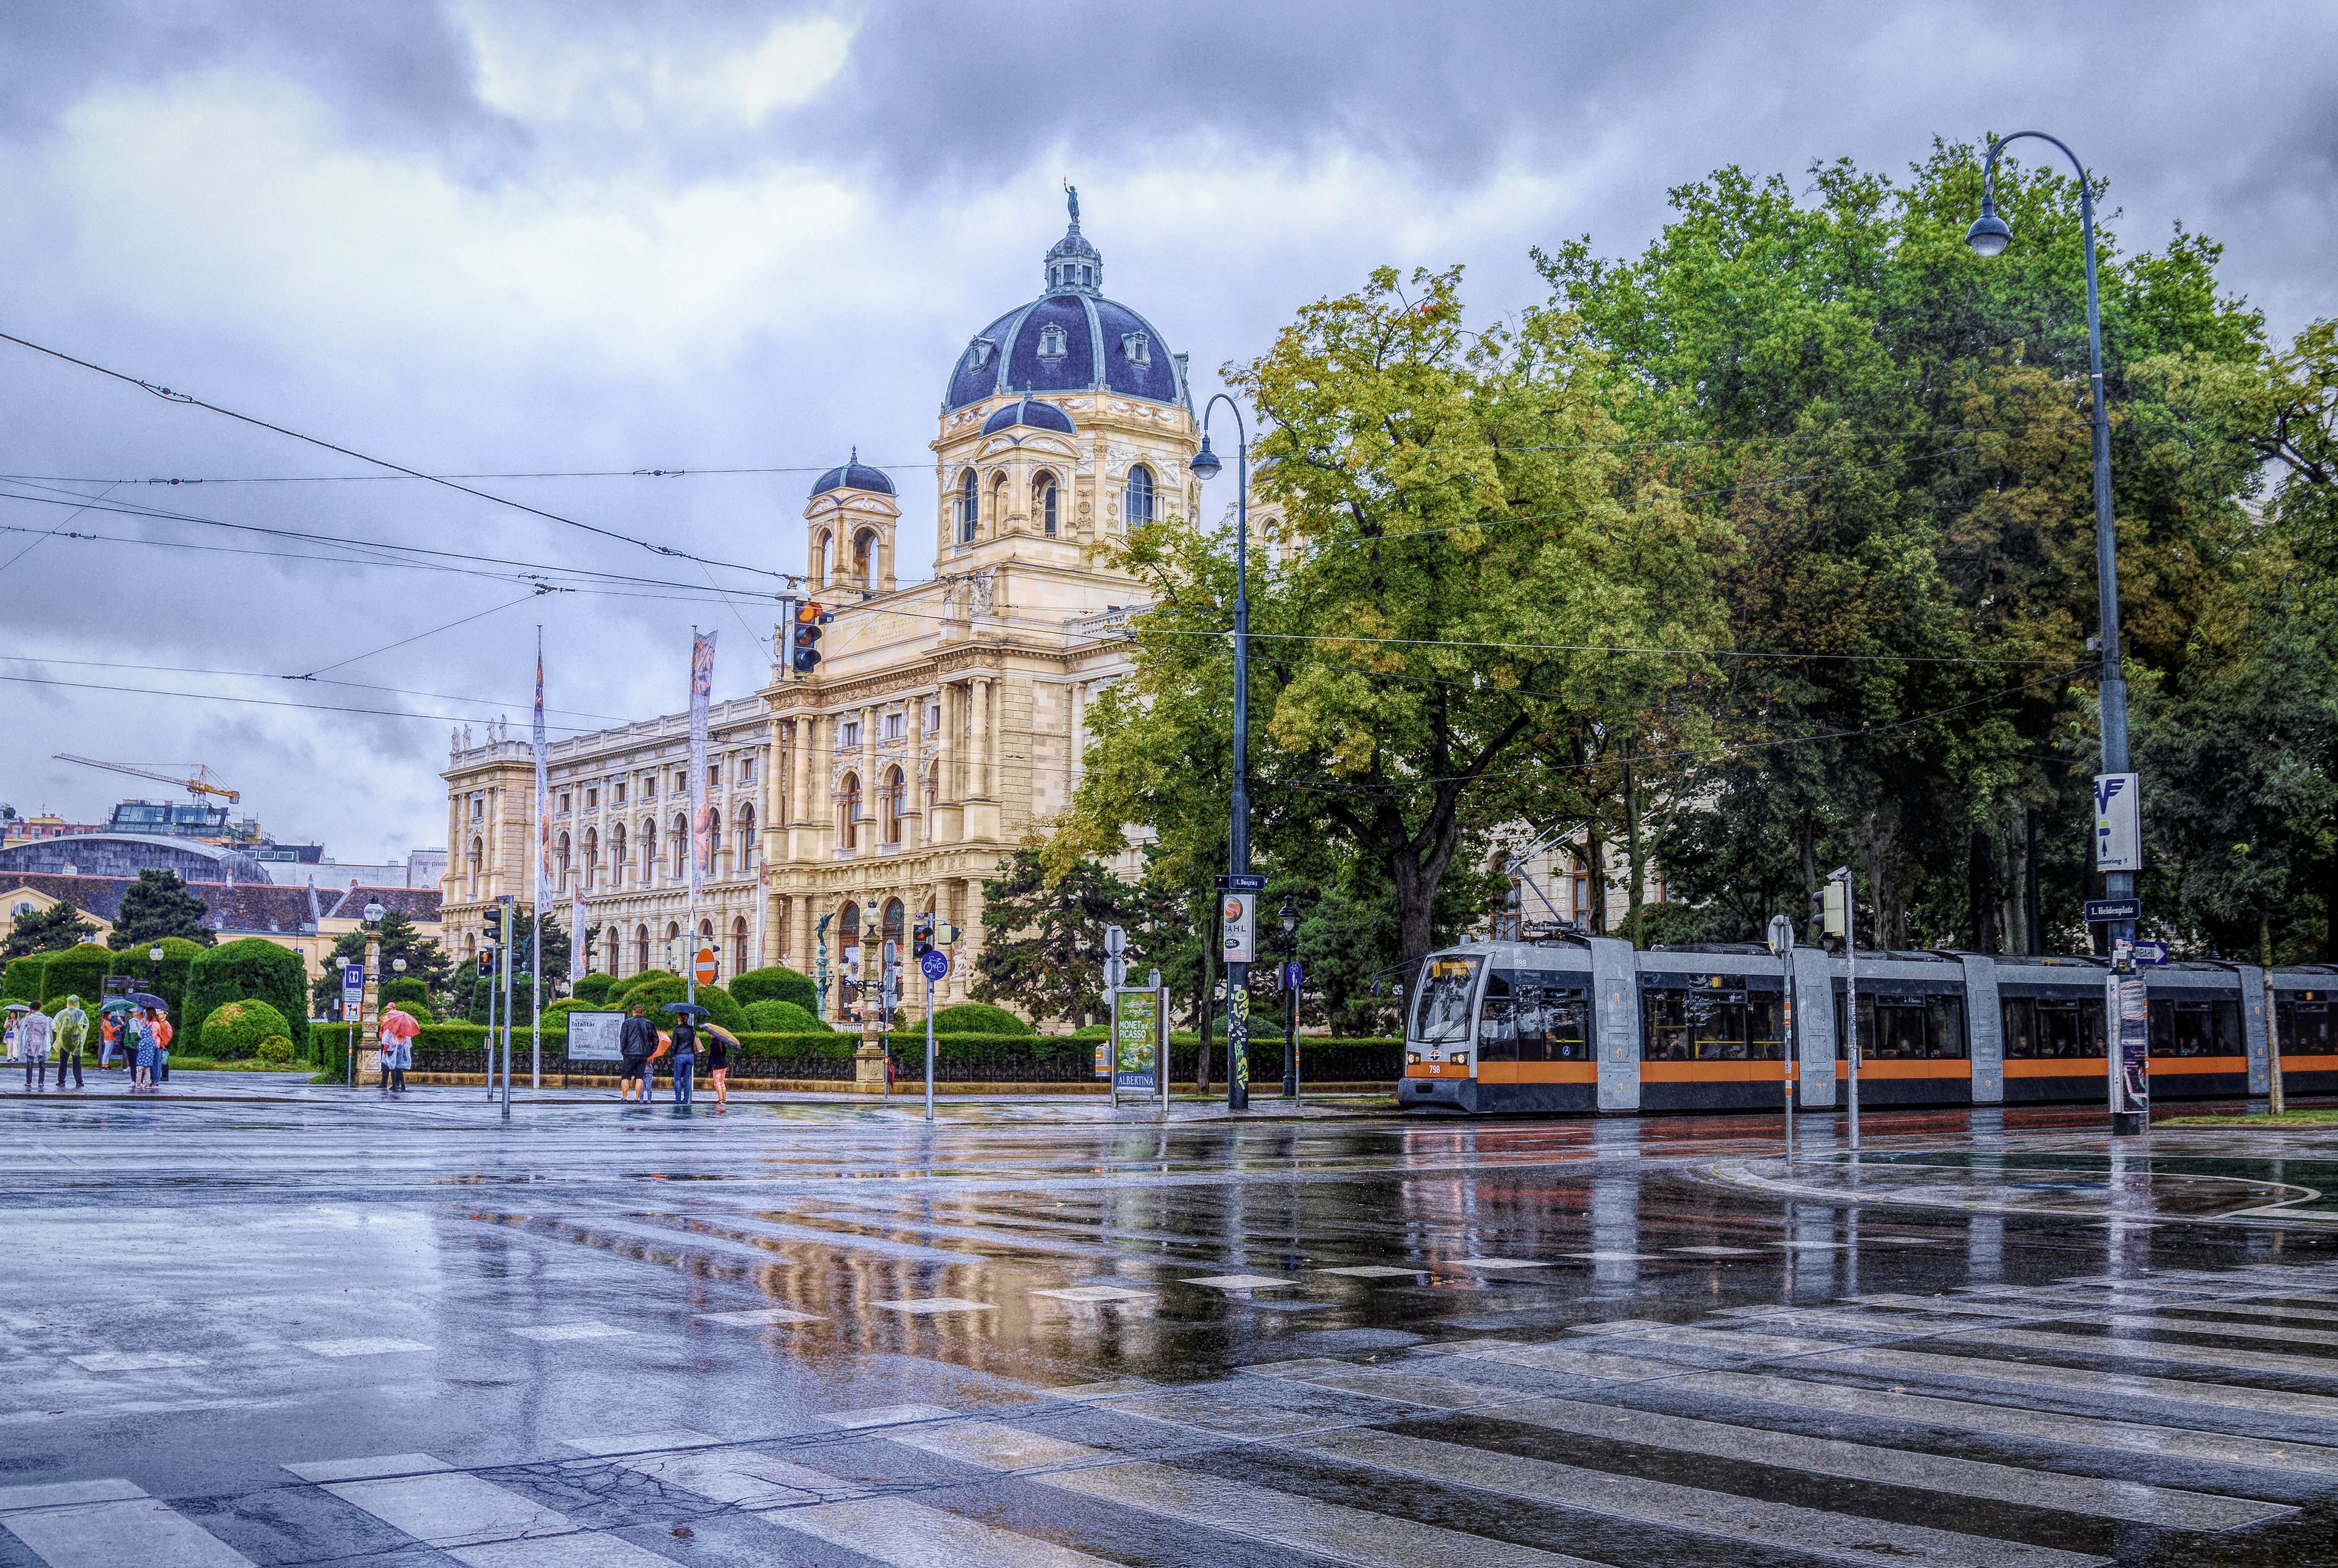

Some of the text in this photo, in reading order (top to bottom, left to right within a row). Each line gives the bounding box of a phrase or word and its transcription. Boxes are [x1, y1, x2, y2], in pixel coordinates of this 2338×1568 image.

[2091, 905, 2133, 916] 1. Heldenplatz
[2136, 947, 2155, 958] NBAHN
[1514, 959, 1527, 967] 798
[1119, 1021, 1142, 1029] MONET
[1119, 1030, 1147, 1038] PICASSO
[1429, 1065, 1440, 1073] 798
[1118, 1075, 1153, 1086] ALBERTINA
